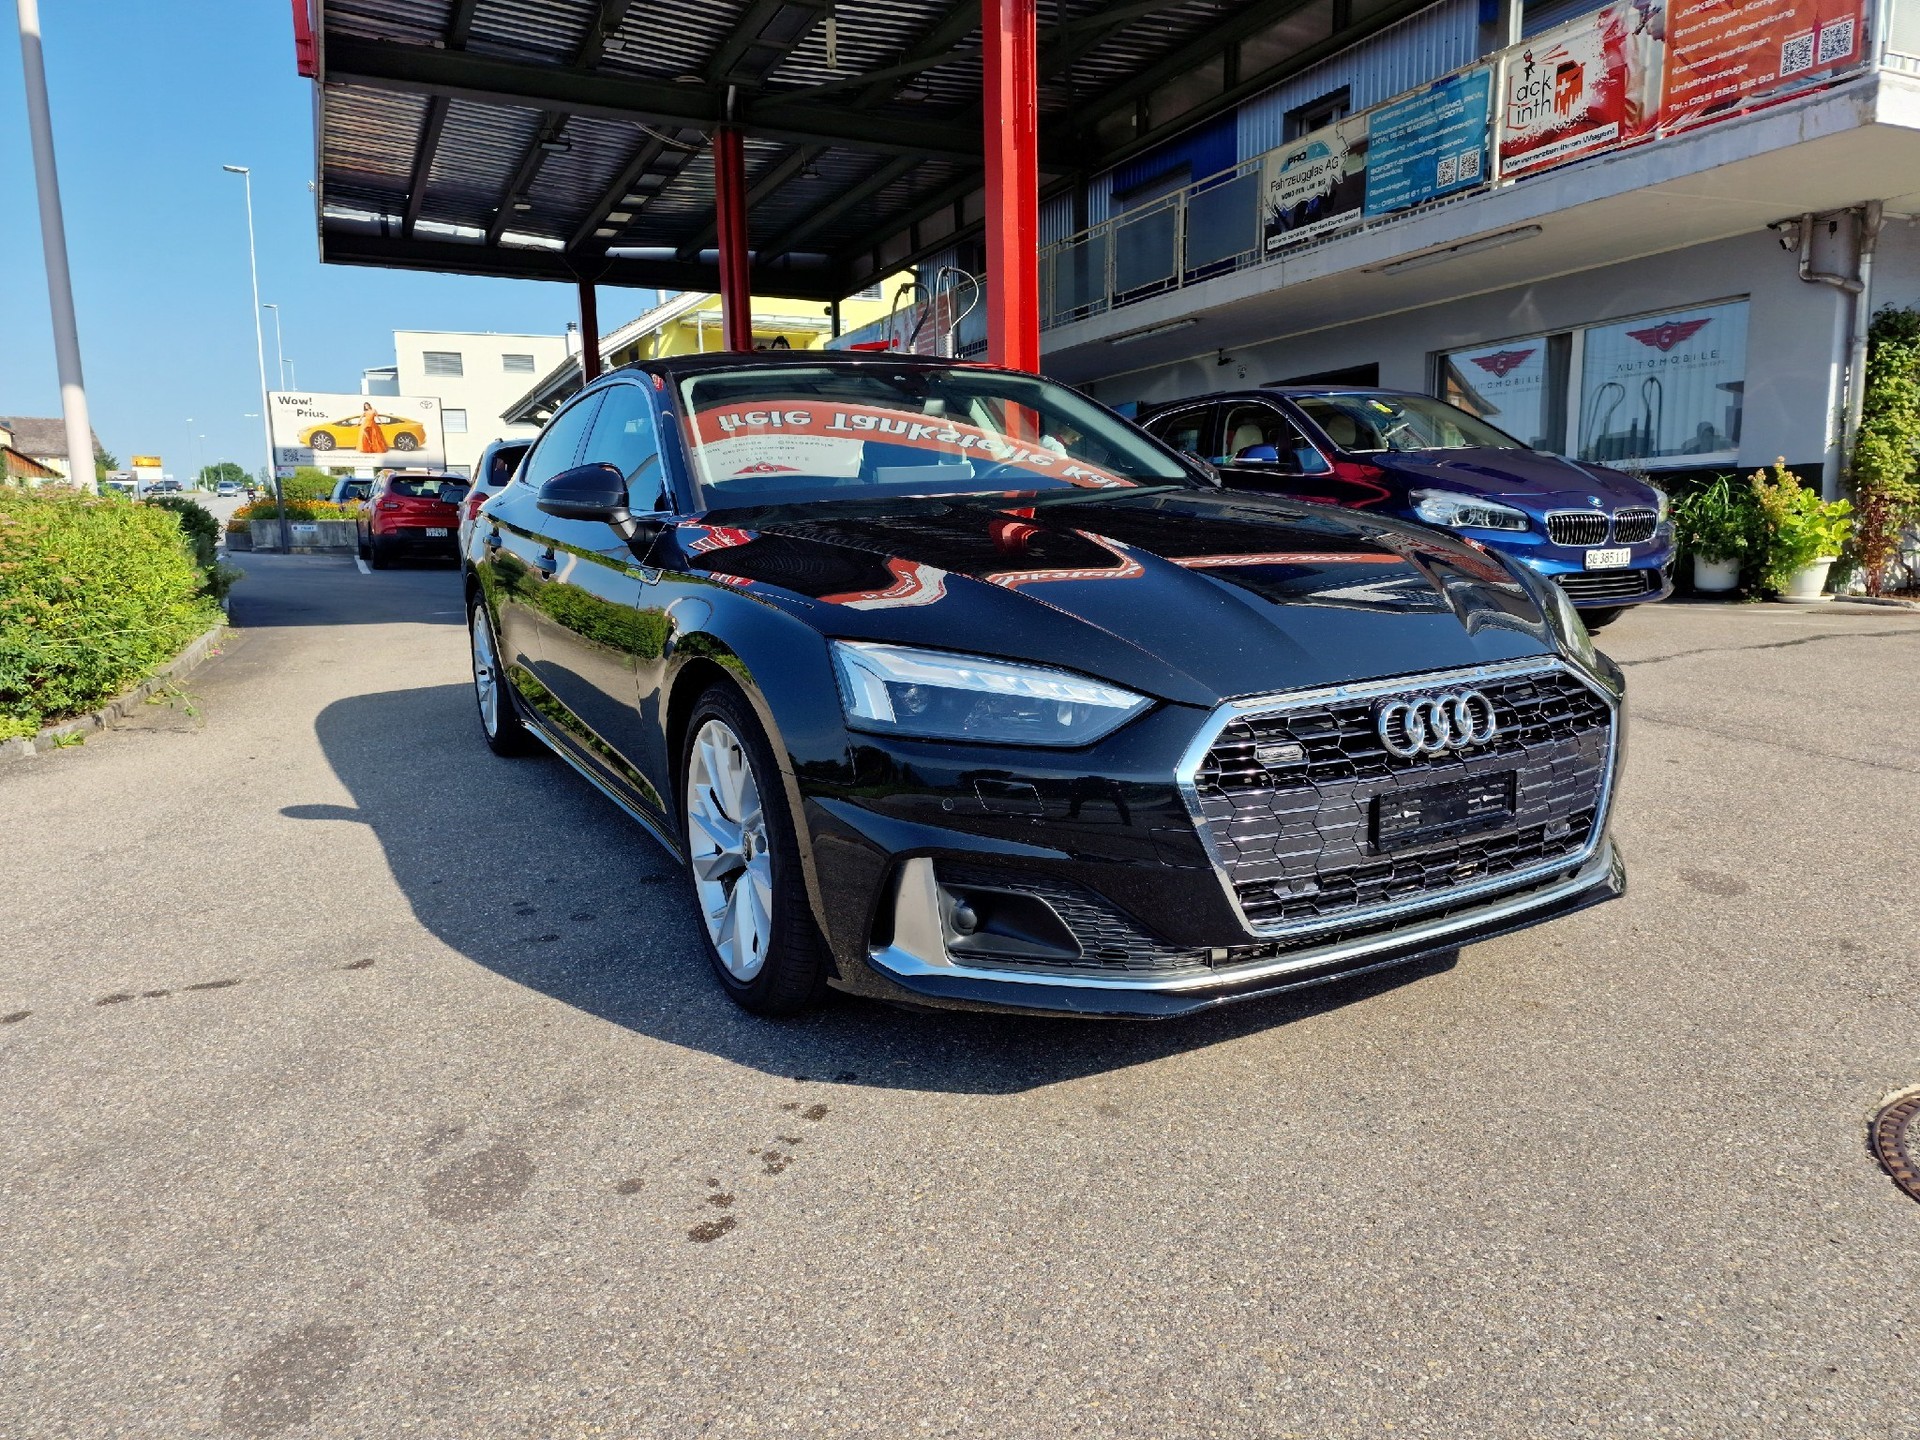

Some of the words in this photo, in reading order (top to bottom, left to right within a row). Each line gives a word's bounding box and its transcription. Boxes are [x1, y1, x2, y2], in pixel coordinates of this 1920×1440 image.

[1672, 37, 1714, 57] Polieren
[1724, 8, 1796, 38] Aufbereitung
[1674, 22, 1706, 38] Smart
[1707, 9, 1744, 26] Repair,
[1507, 70, 1552, 106] Lack
[1670, 62, 1748, 94] Unfallfahrzeuge
[1288, 152, 1306, 166] PRO
[1270, 163, 1324, 192] Fahrzeugglas
[1325, 156, 1339, 172] AG
[1616, 349, 1719, 373] AUTOMOBILE
[278, 396, 312, 406] Wow!
[296, 408, 328, 418] Prius.
[1588, 553, 1598, 564] SG
